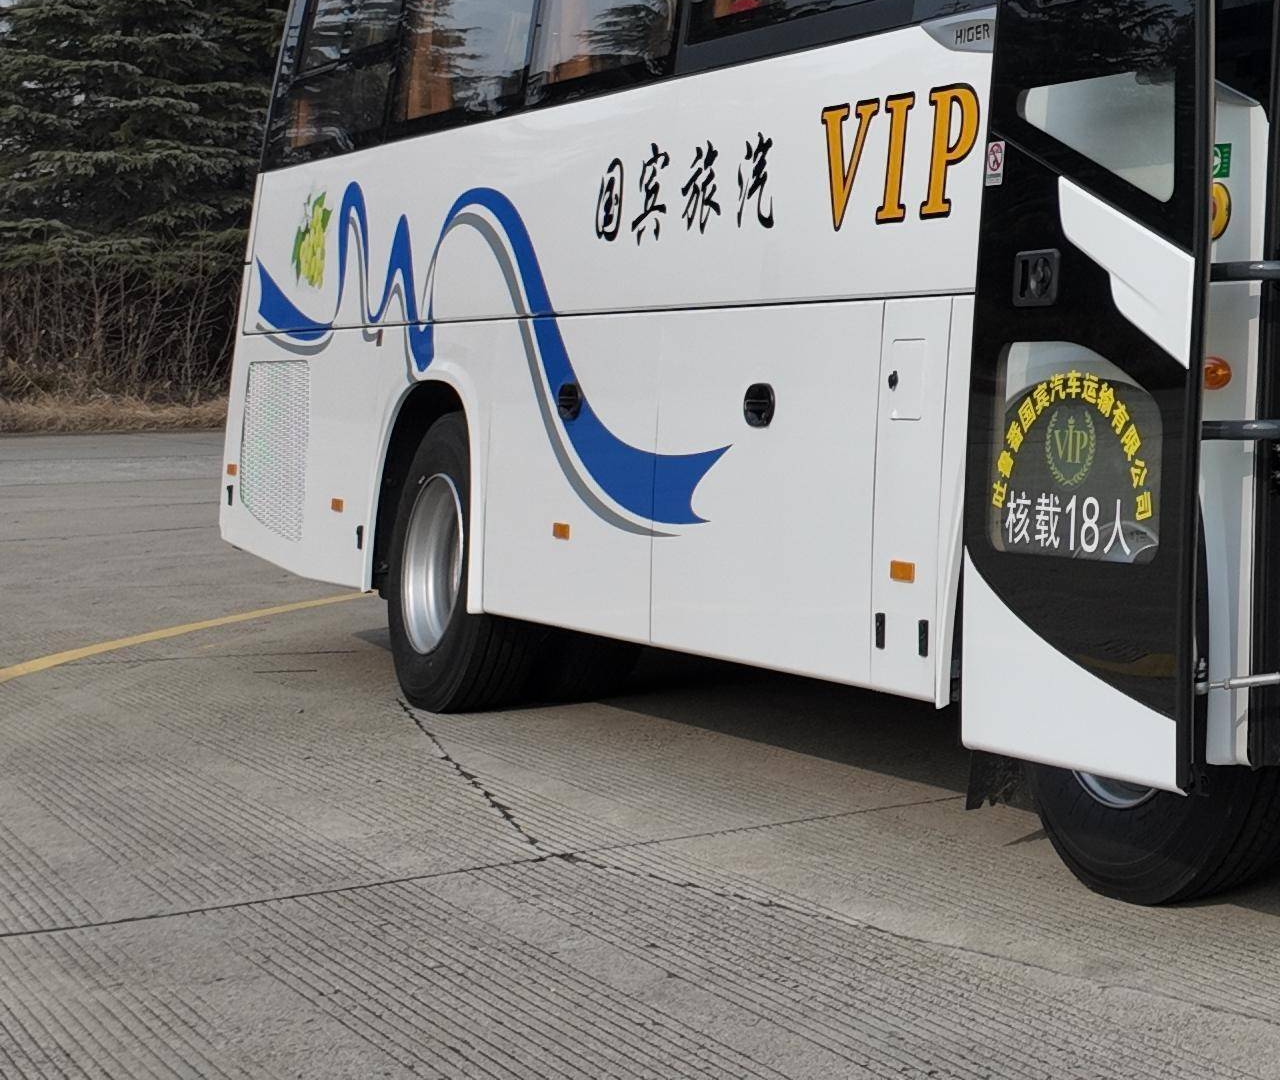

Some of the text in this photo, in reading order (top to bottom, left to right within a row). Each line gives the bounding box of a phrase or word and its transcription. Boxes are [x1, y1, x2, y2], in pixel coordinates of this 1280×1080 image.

[954, 23, 990, 45] HIGER
[821, 83, 981, 232] VIP
[1054, 423, 1088, 464] VIP
[1005, 490, 1132, 556] 核载18人
